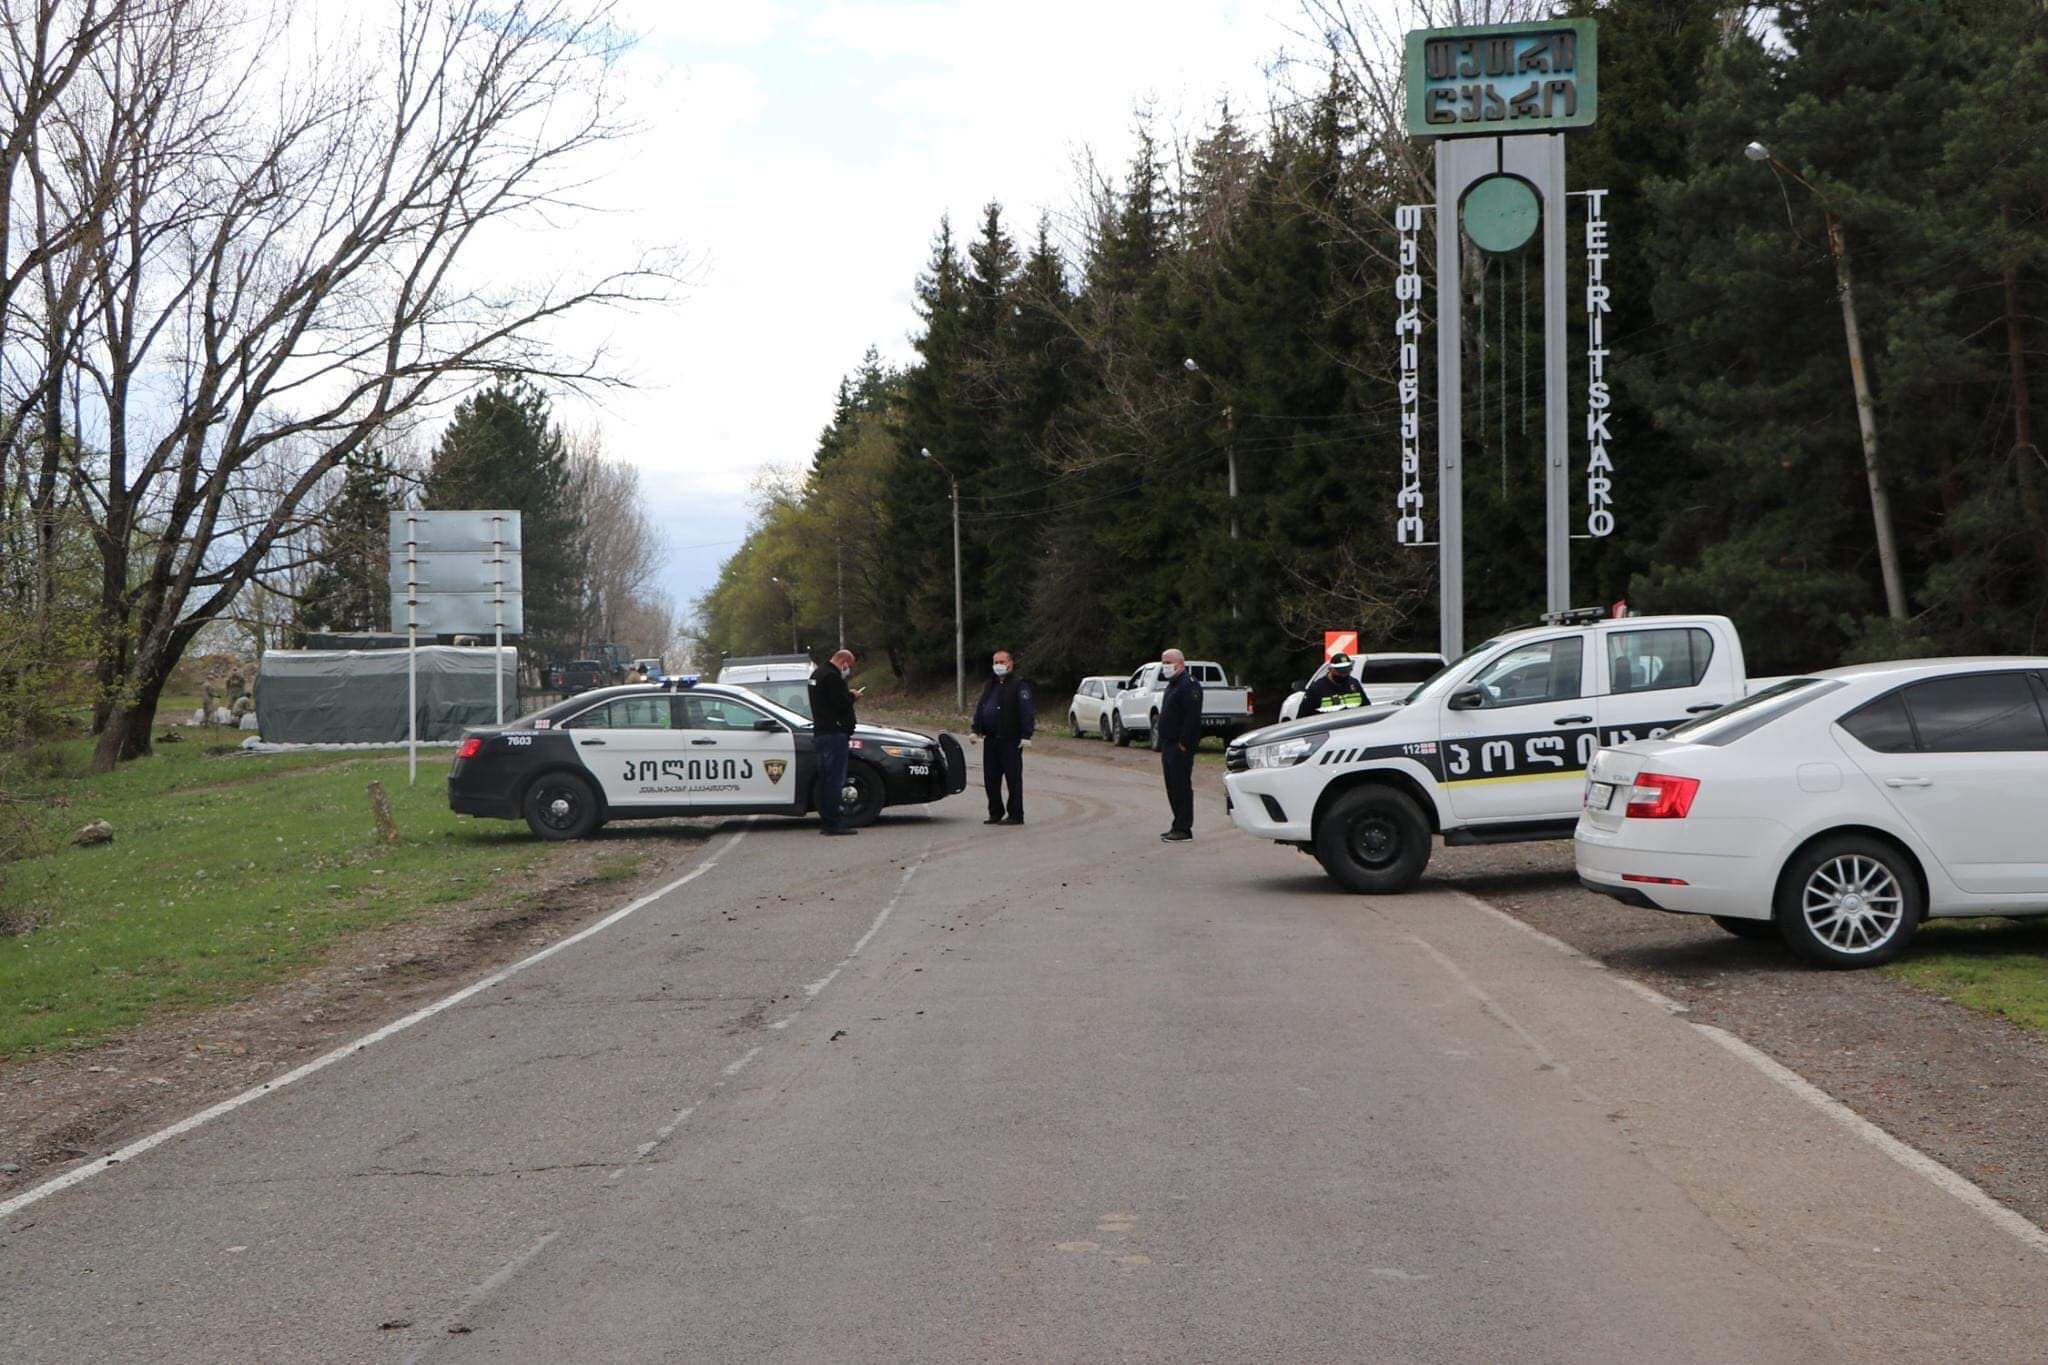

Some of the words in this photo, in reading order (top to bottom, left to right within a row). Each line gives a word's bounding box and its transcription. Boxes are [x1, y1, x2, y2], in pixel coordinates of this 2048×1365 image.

[1427, 34, 1576, 80] თეთრი
[1395, 206, 1423, 543] თეთრიწყარო
[1586, 189, 1614, 537] TETRITSKARO
[507, 736, 532, 746] 7603
[848, 740, 861, 749] 12
[1402, 744, 1420, 755] 112
[1449, 728, 1669, 774] პოლი
[623, 758, 753, 781] პოლიცია
[909, 765, 929, 775] 7603
